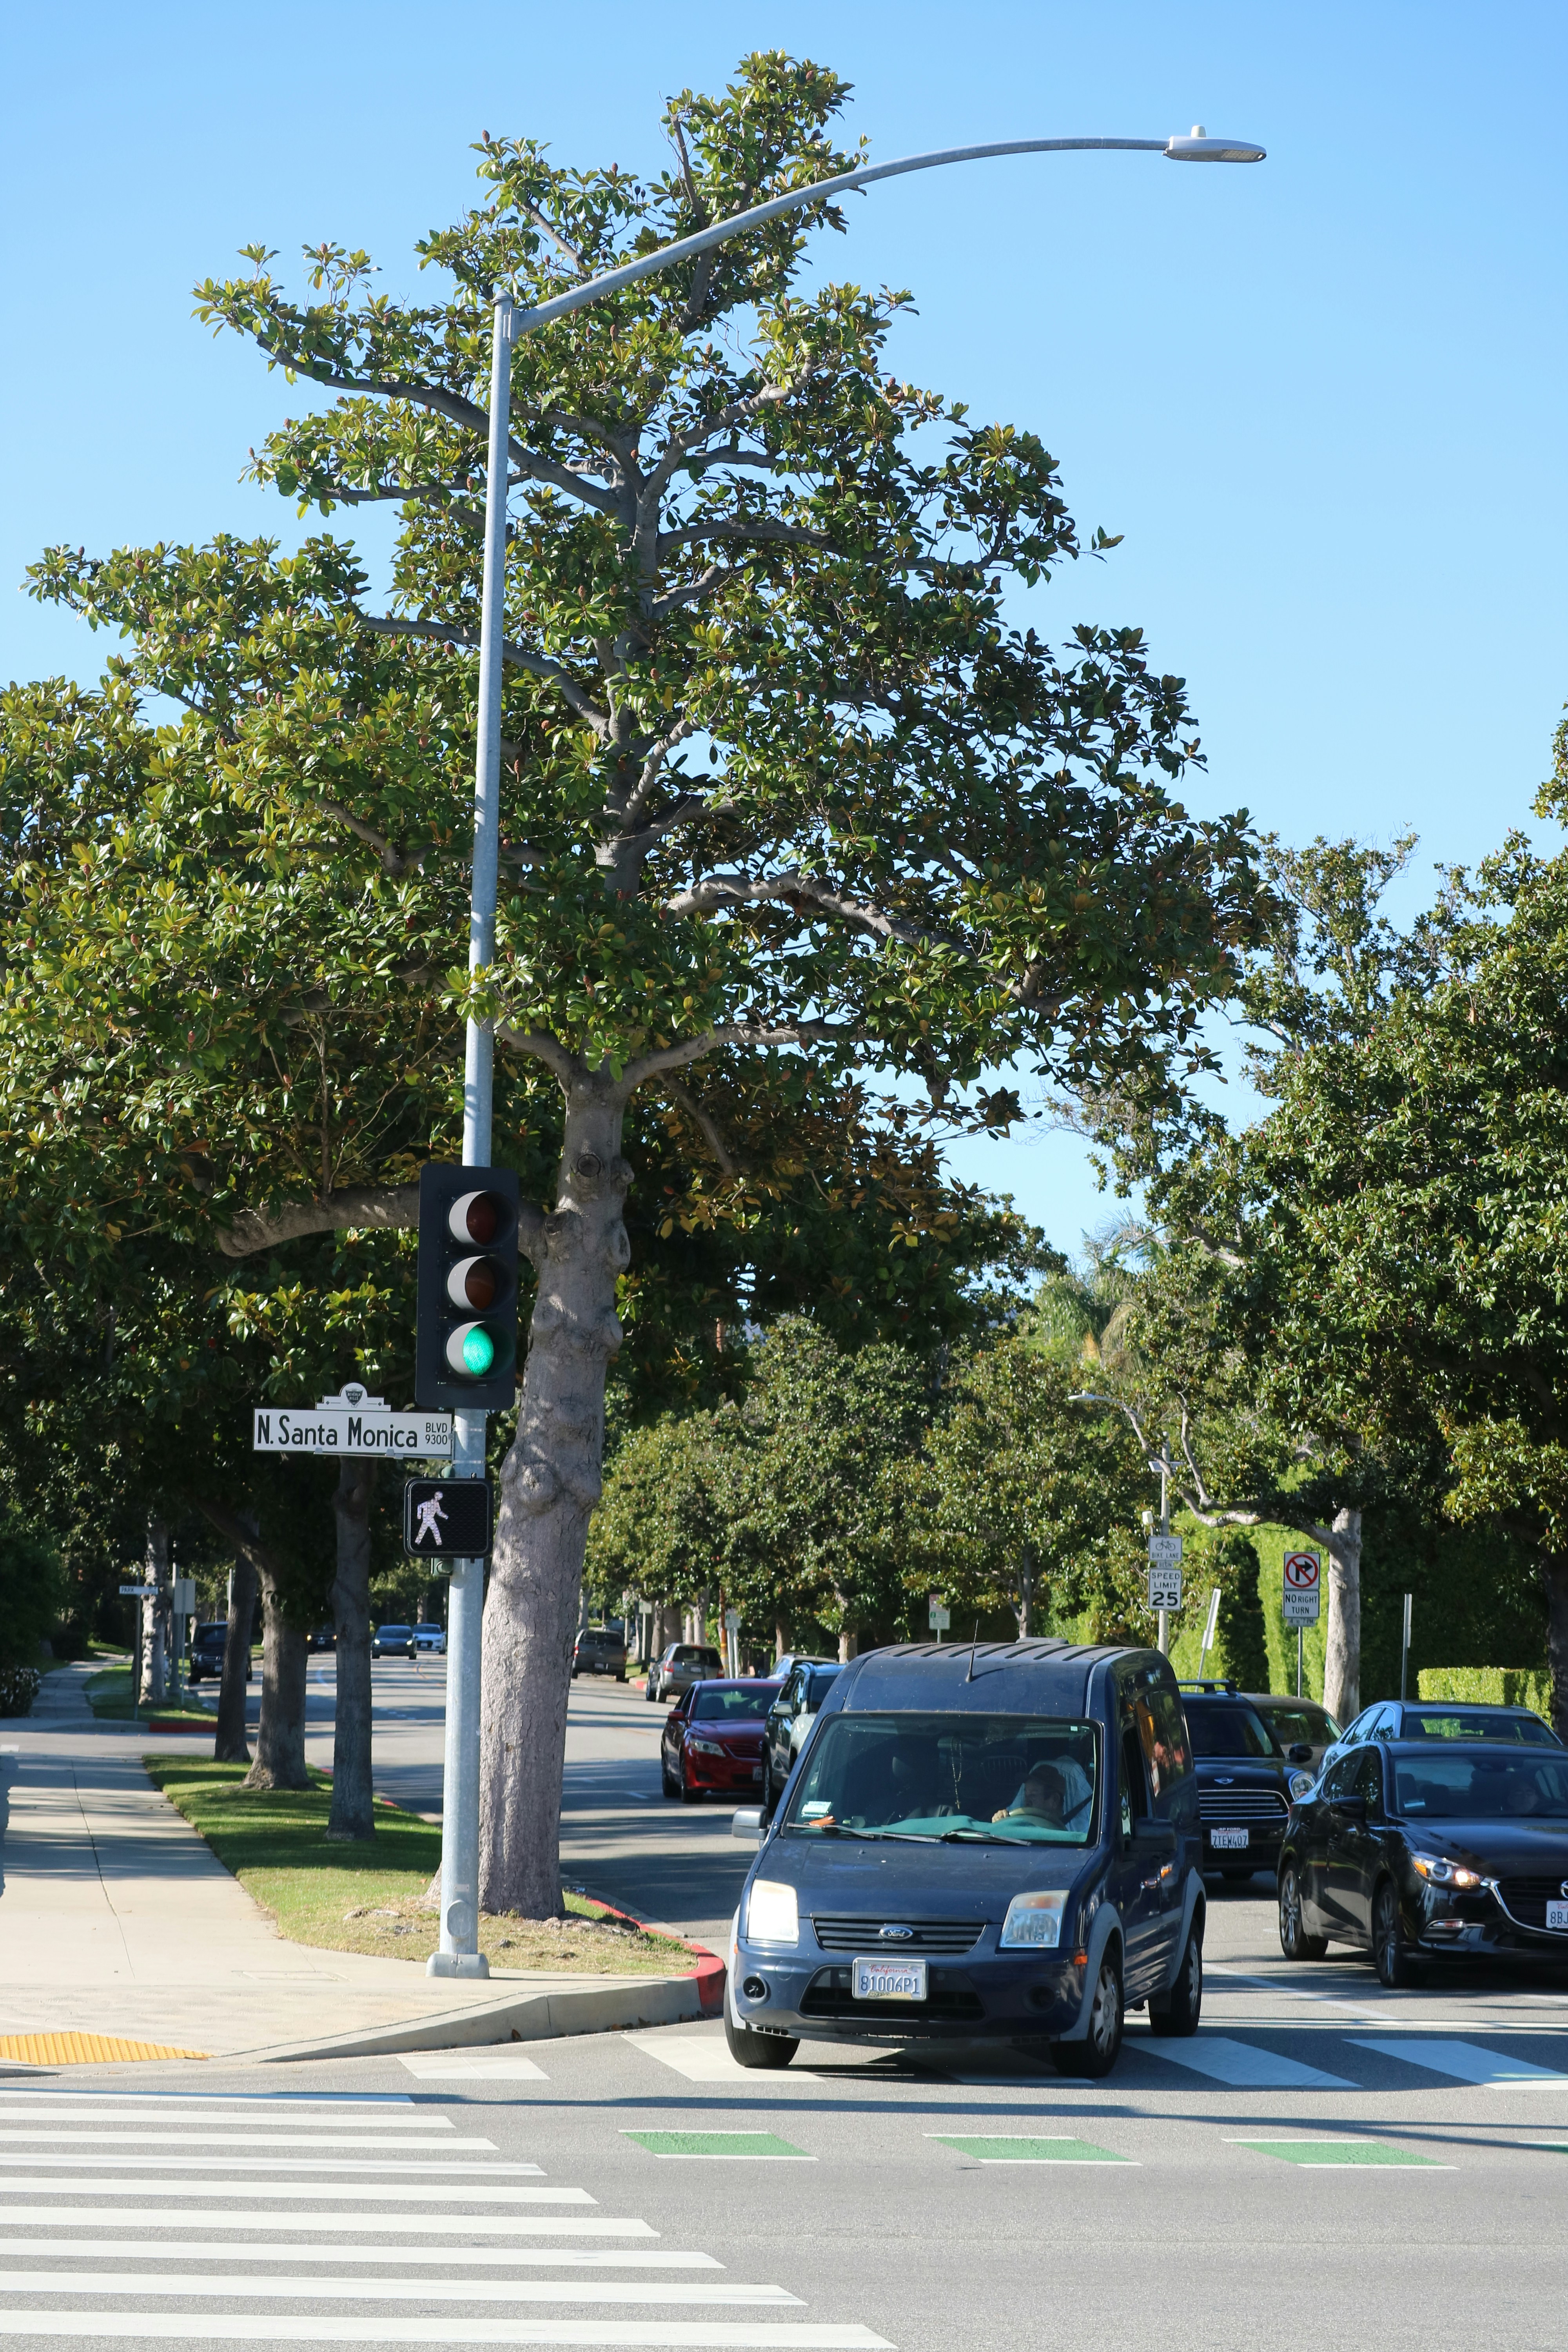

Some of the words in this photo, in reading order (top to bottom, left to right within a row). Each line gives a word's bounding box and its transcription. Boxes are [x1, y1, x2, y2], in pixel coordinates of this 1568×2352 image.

[258, 1415, 274, 1444] N.
[278, 1415, 338, 1446] Santa
[348, 1417, 418, 1448] Monica
[425, 1422, 448, 1433] BLVD
[425, 1434, 448, 1445] 9300
[1152, 1591, 1178, 1606] 25
[1285, 1594, 1296, 1603] NO
[870, 1964, 912, 1975] California
